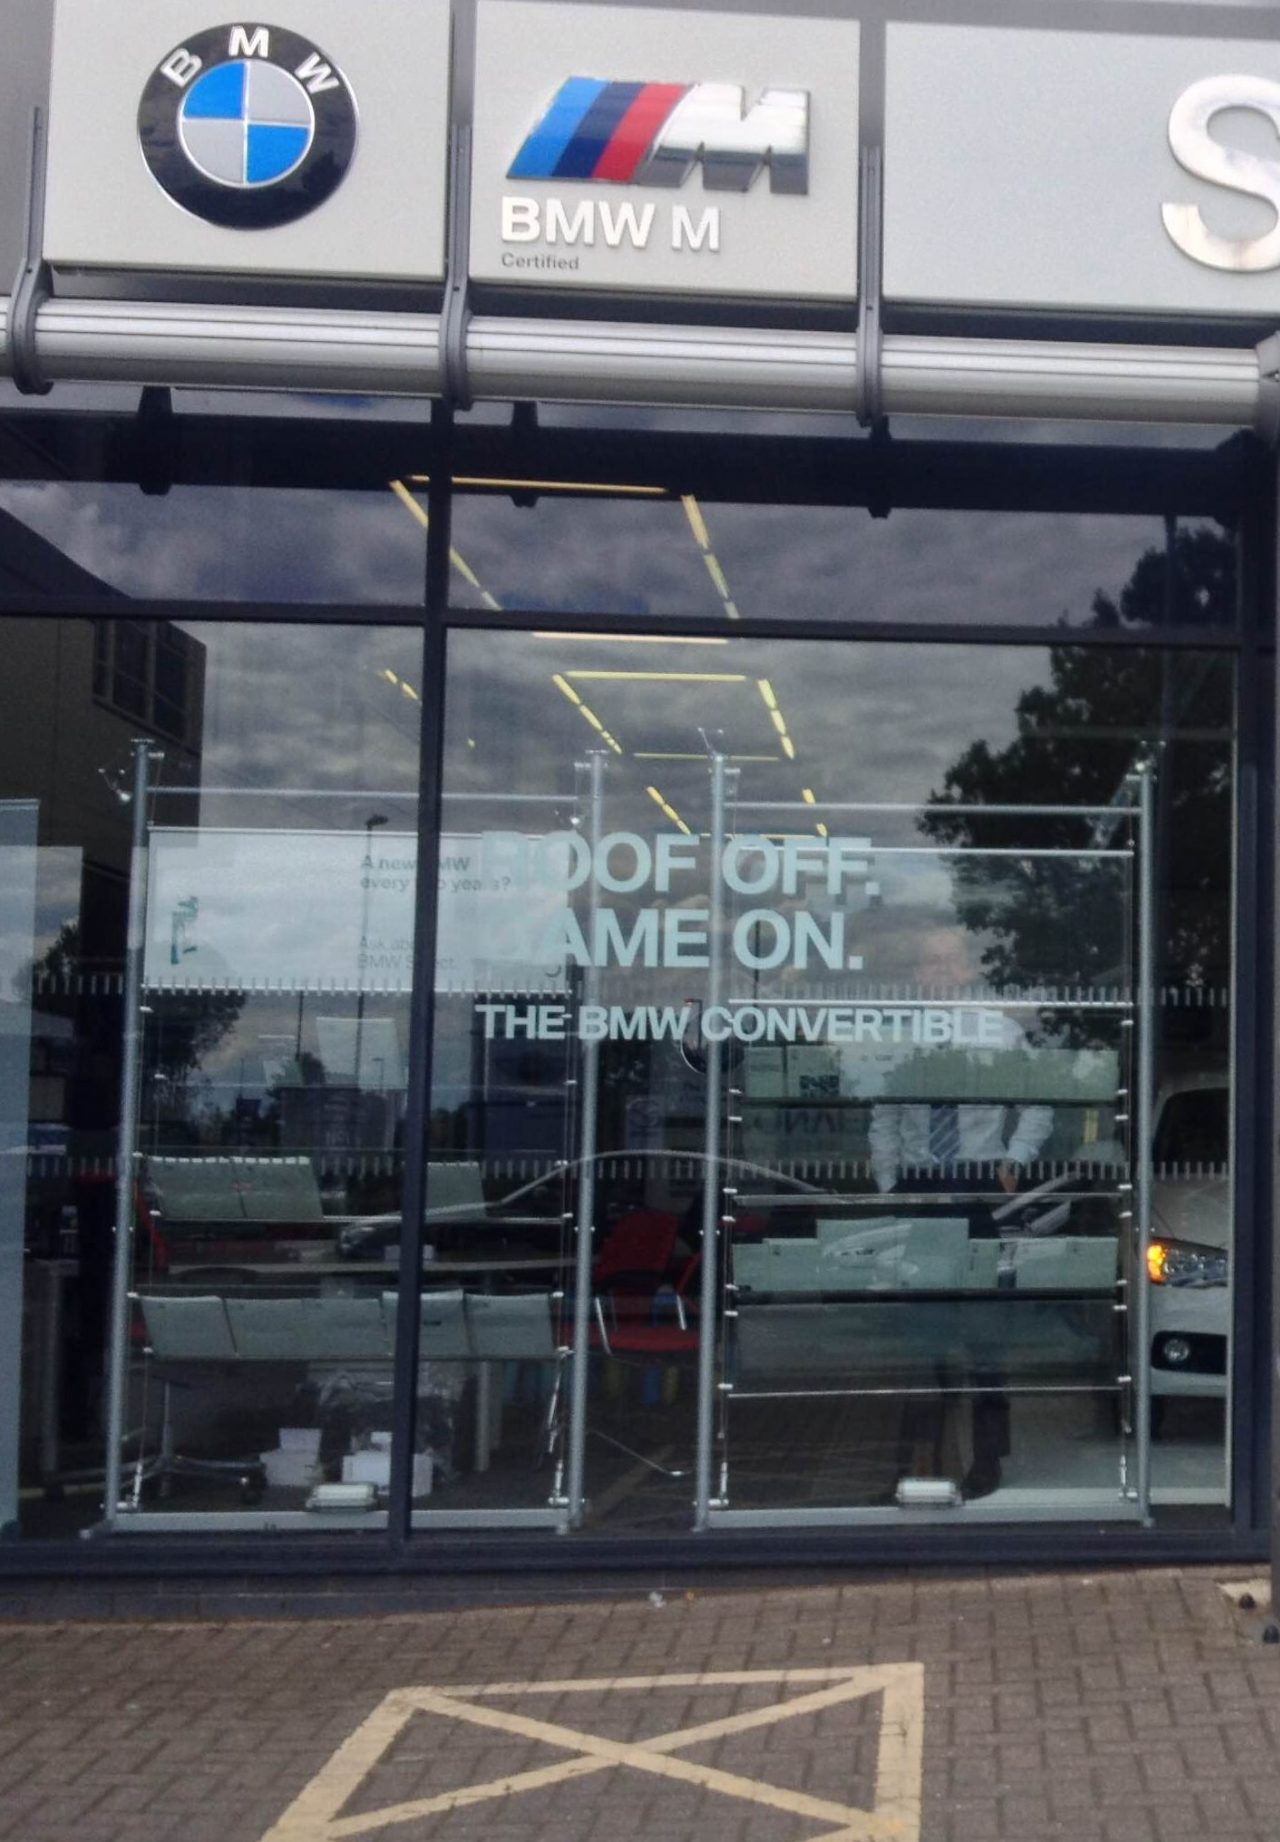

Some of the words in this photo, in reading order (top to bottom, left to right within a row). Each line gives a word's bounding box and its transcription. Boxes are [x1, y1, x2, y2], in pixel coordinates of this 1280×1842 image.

[160, 25, 340, 95] BMW
[500, 195, 656, 249] BMW
[671, 204, 721, 252] M
[500, 253, 580, 271] Certified
[360, 876, 411, 892] every
[721, 834, 881, 896] OFF.
[534, 906, 710, 968] AME
[732, 908, 864, 970] ON.
[474, 1004, 567, 1041] THE
[578, 1004, 691, 1042] BMW
[701, 1005, 1005, 1045] CONVERTIBLE
